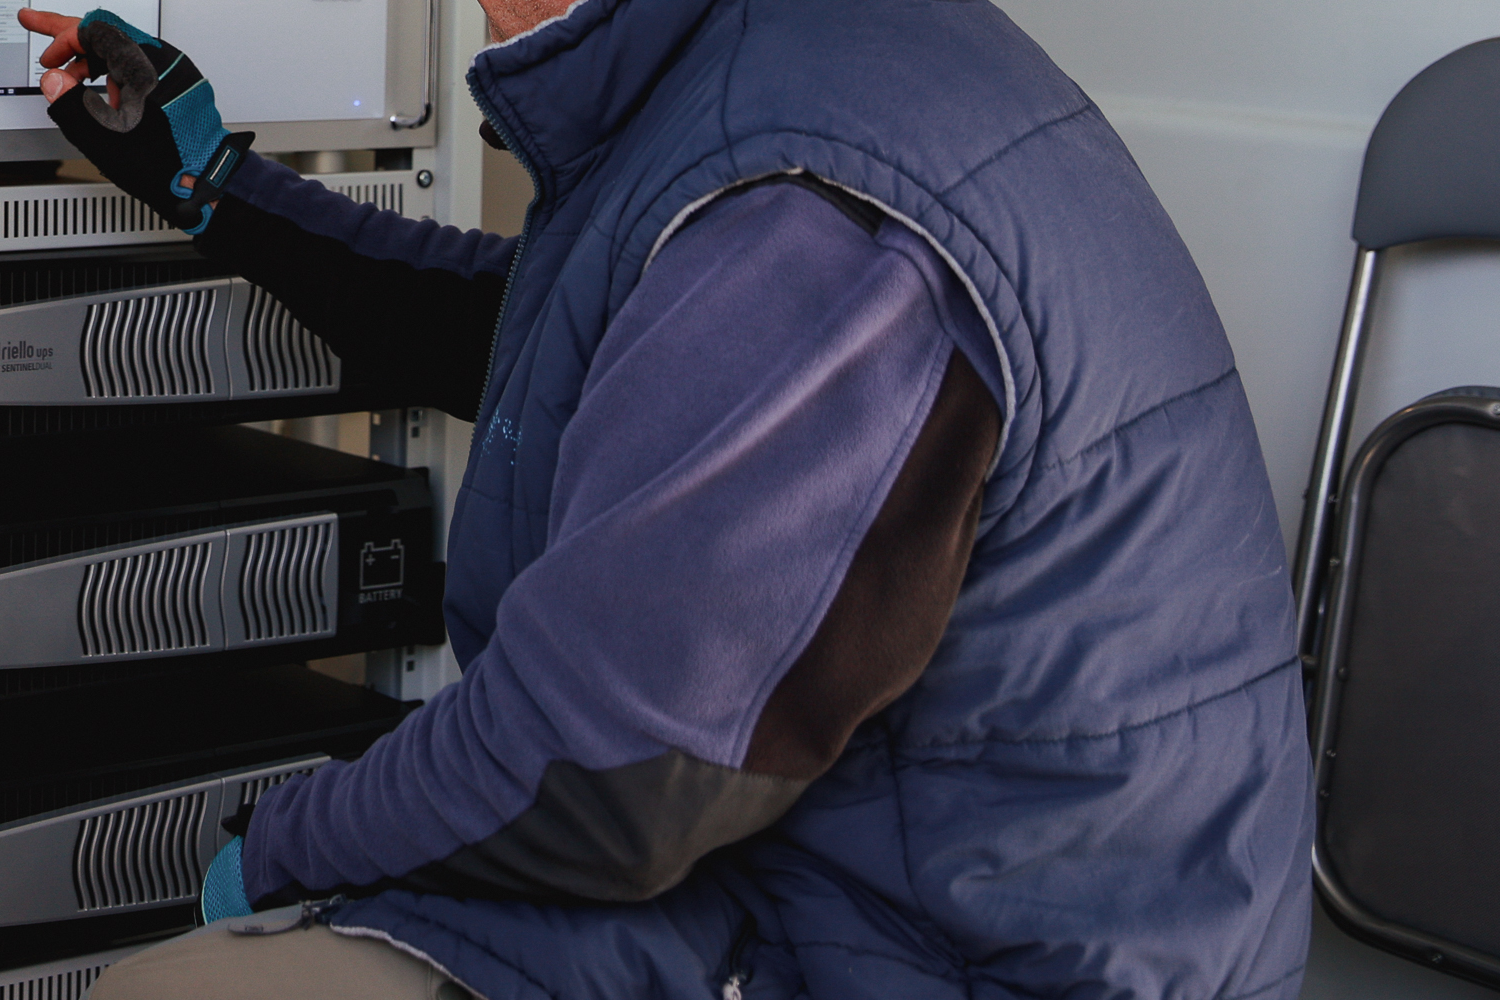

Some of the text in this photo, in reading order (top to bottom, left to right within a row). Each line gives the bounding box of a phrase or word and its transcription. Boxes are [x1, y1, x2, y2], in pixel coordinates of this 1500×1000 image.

[2, 341, 53, 360] riello ups
[359, 588, 403, 604] BATTERY
